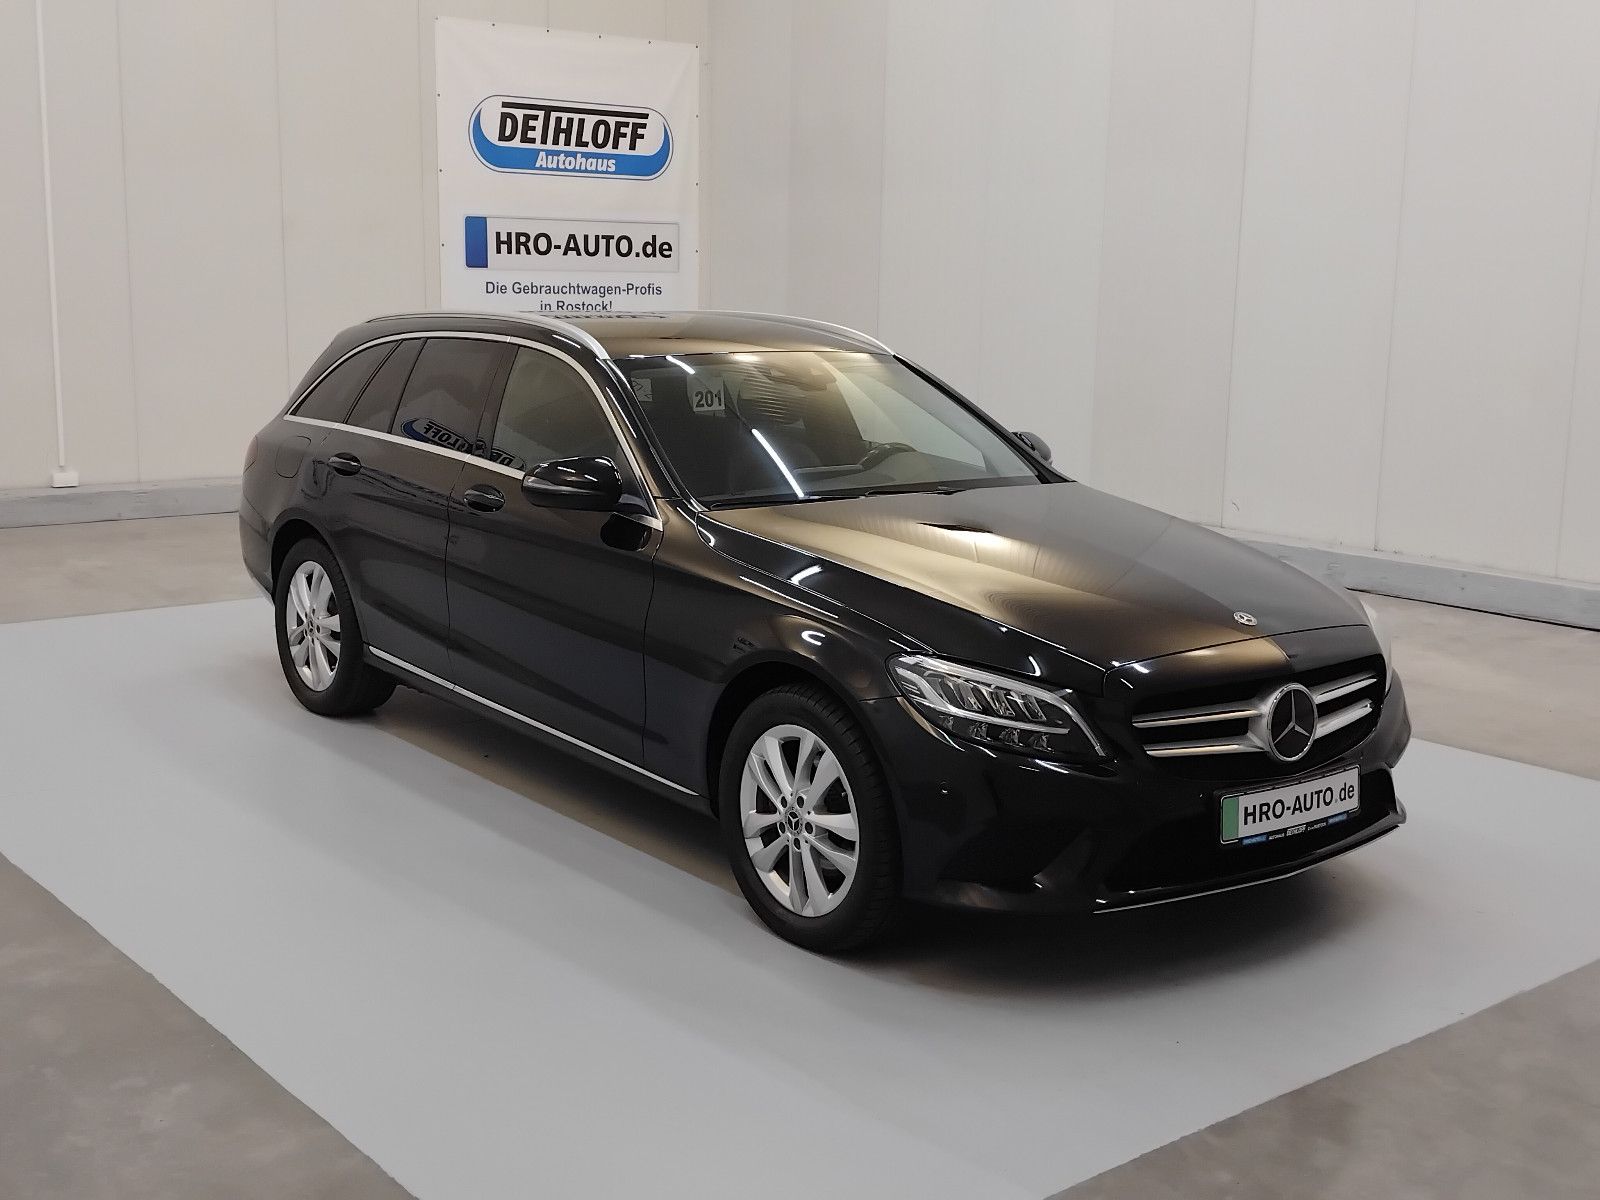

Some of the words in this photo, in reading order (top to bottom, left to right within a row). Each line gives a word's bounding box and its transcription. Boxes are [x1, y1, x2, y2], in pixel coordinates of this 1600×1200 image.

[497, 101, 650, 151] DETHLOFF
[535, 151, 616, 172] Autohaus
[495, 231, 673, 259] HRO-AUTO.de
[485, 281, 507, 295] Die
[512, 281, 663, 298] Gebrauchtwagen-Profis
[540, 300, 552, 311] in
[556, 300, 613, 311] Rostock!
[694, 390, 722, 408] 201
[1243, 782, 1355, 826] HRO-AUTO.de
